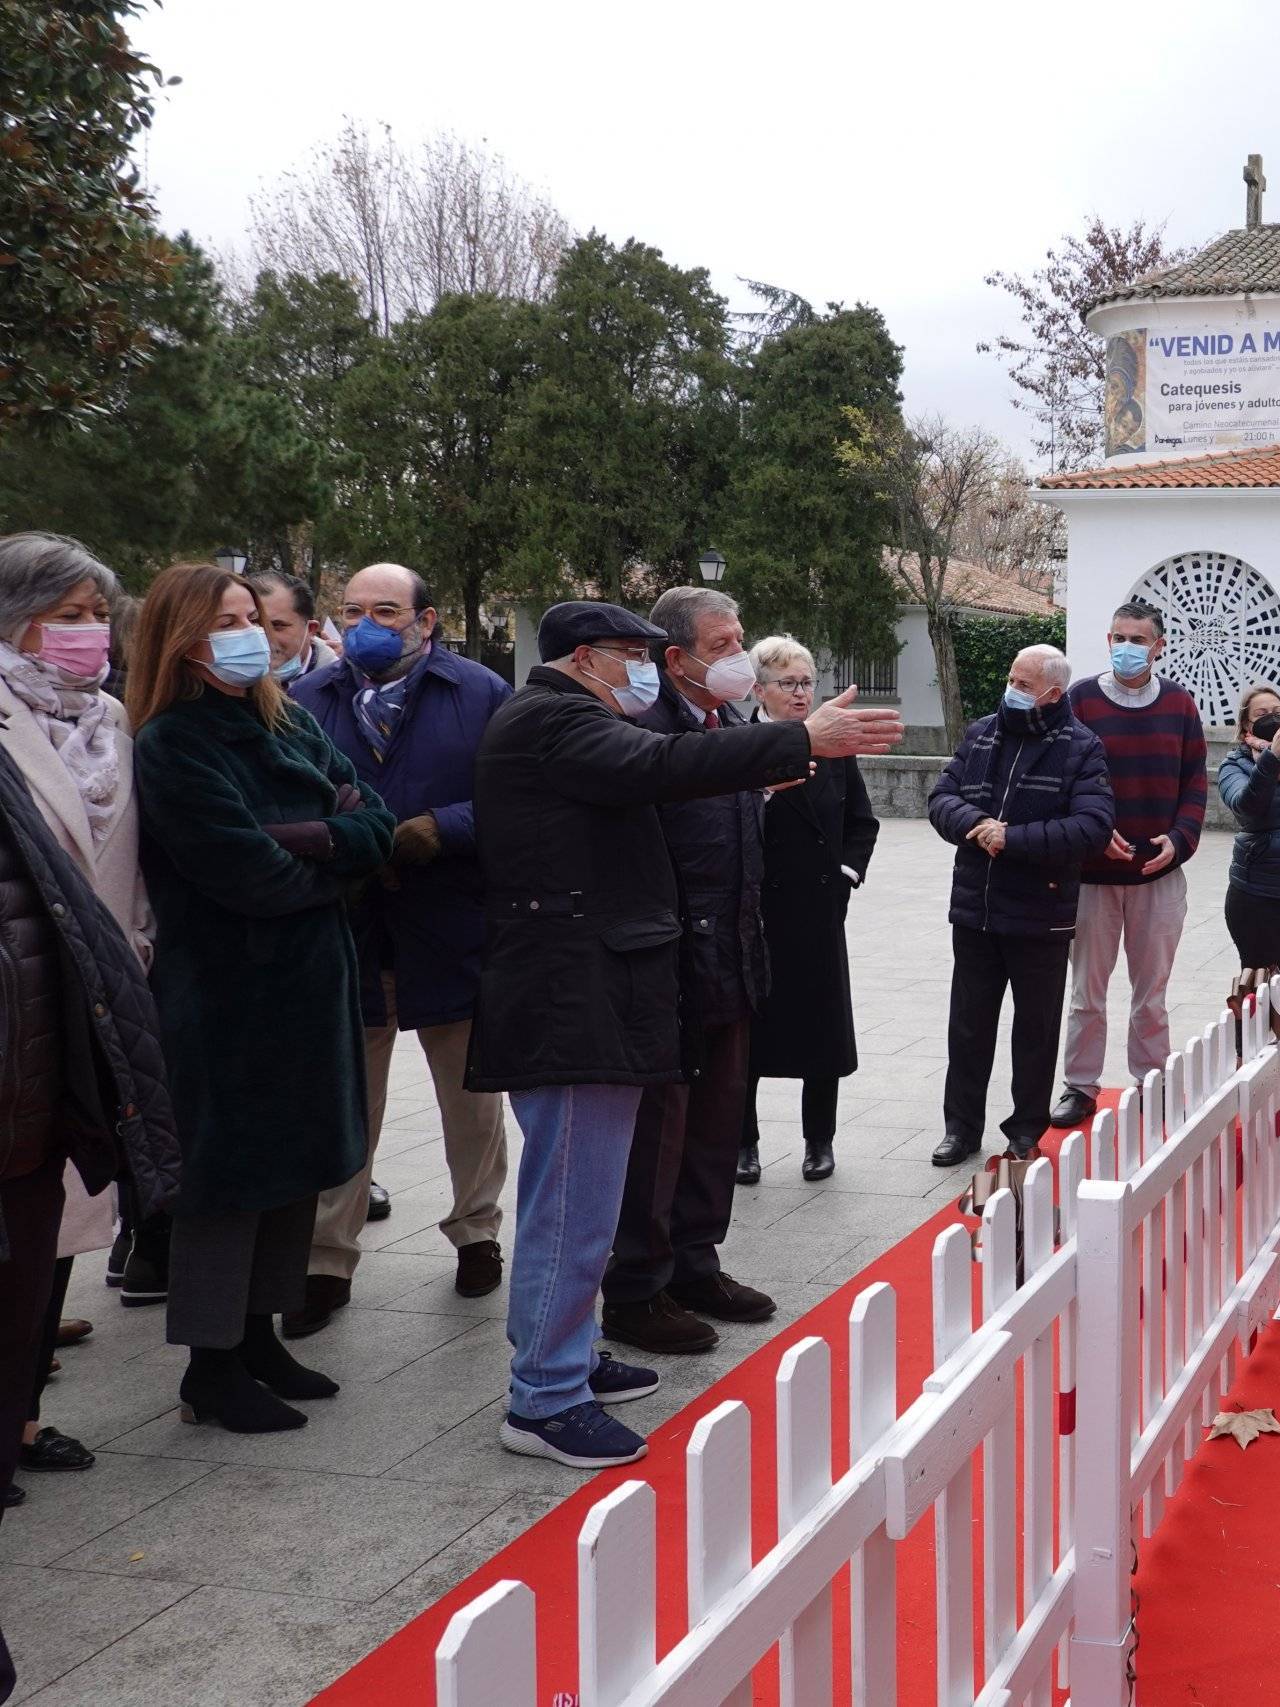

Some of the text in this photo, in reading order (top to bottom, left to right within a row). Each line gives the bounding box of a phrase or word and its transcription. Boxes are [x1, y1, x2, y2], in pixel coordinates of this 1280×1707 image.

[1239, 333, 1257, 354] A
[1160, 381, 1242, 397] Catequesis
[1168, 402, 1192, 413] para
[1195, 400, 1236, 412] jóvenes
[1239, 400, 1245, 410] y
[1183, 420, 1212, 430] Camino
[1183, 435, 1207, 444] Lunes
[1244, 431, 1267, 441] 21:00
